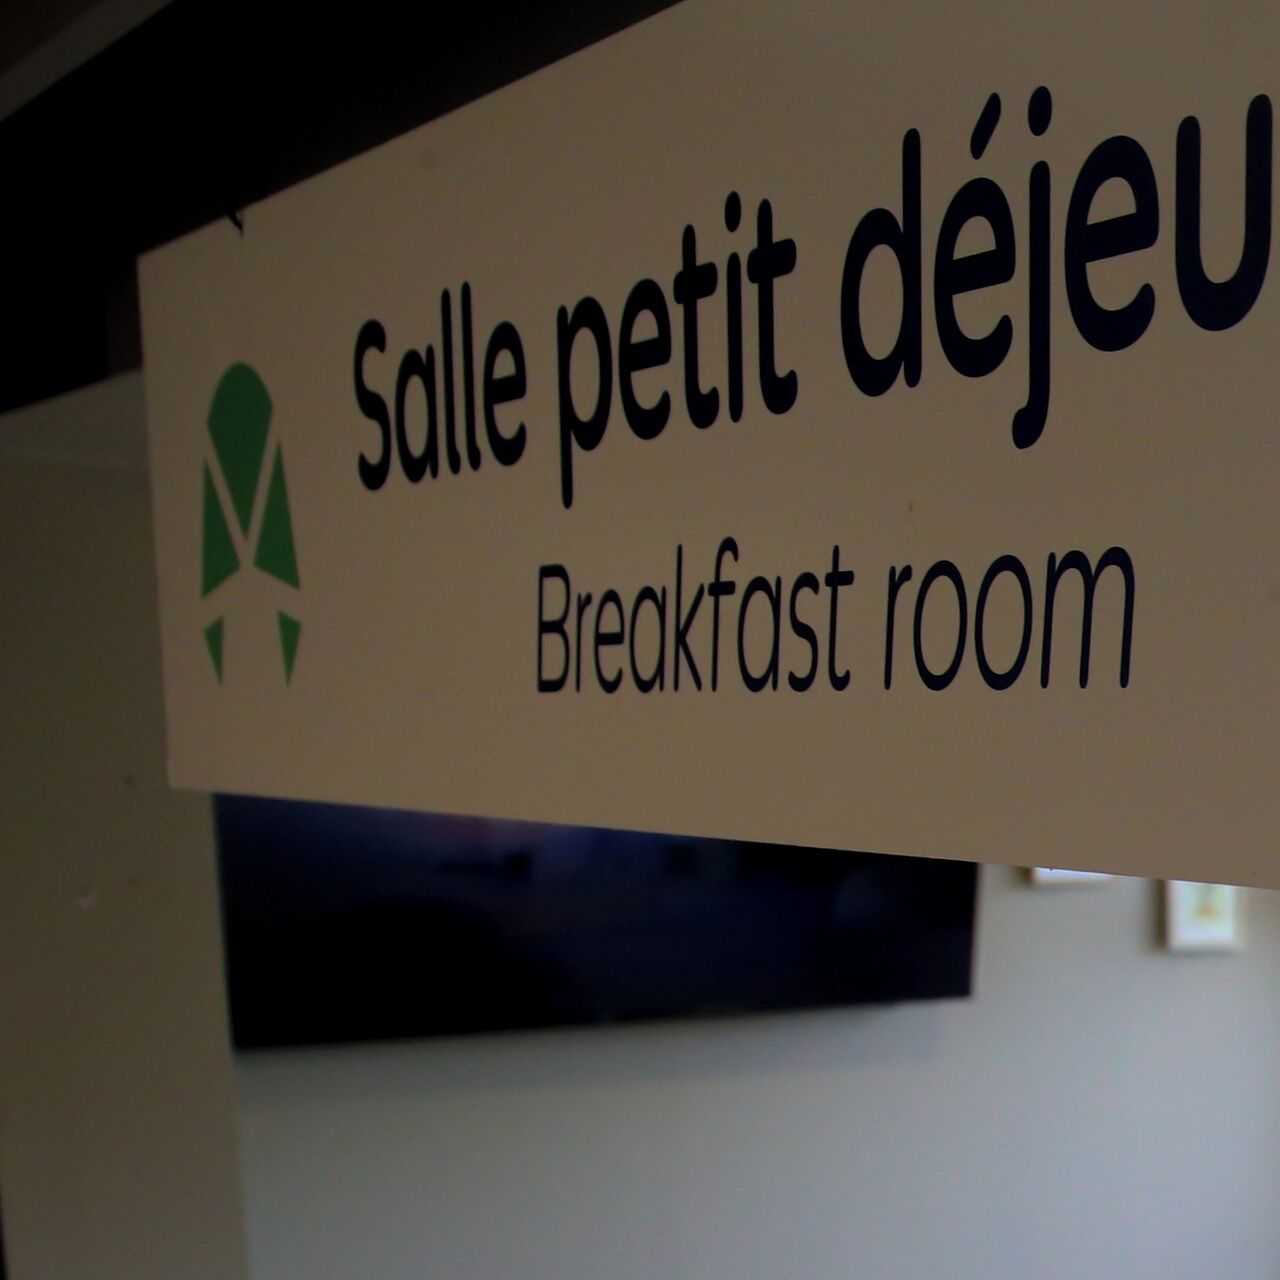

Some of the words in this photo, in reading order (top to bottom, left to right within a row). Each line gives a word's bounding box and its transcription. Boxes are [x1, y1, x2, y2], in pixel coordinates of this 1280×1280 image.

[352, 280, 528, 492] Salle
[556, 190, 799, 510] petit
[536, 536, 856, 695] Breakfast
[882, 545, 1137, 693] room
